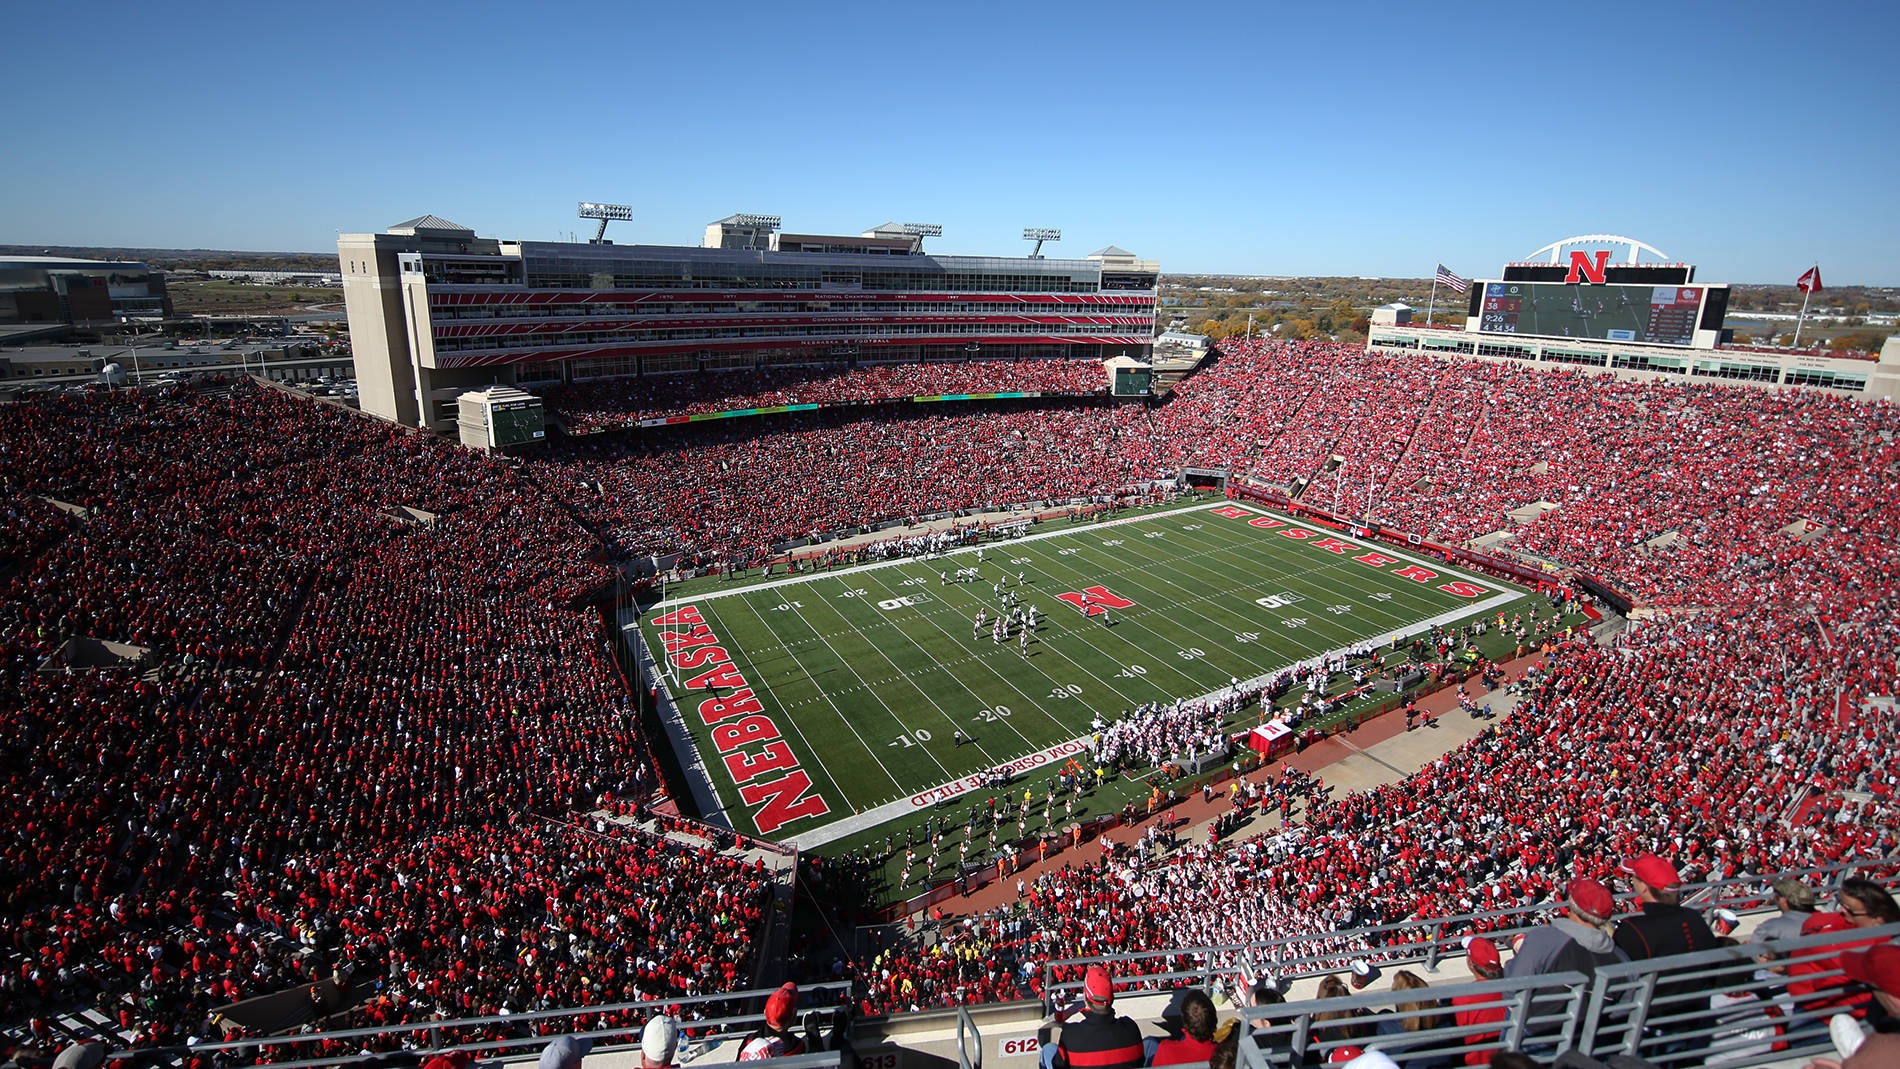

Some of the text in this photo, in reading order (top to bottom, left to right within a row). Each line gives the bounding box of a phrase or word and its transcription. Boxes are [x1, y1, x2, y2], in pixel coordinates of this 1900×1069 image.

[1565, 250, 1612, 285] N
[1485, 314, 1504, 322] 9:26
[1209, 507, 1490, 598] HUSKERS
[902, 577, 927, 586] 30
[842, 588, 868, 598] 20
[1368, 592, 1390, 602] 10
[778, 600, 806, 612] 10
[1055, 585, 1137, 617] N
[1326, 604, 1348, 614] 20
[1280, 618, 1305, 628] 30
[1234, 632, 1258, 644] 40
[1176, 647, 1206, 660] 50
[1120, 664, 1148, 679] 40
[1052, 684, 1084, 700] 30
[650, 605, 831, 836] NEBRASKA
[979, 704, 1012, 723] 20
[896, 728, 932, 750] 10
[1046, 740, 1088, 759] TOM
[911, 782, 966, 807] FIELD
[1004, 1038, 1038, 1054] 612
[862, 1054, 897, 1069] 613
